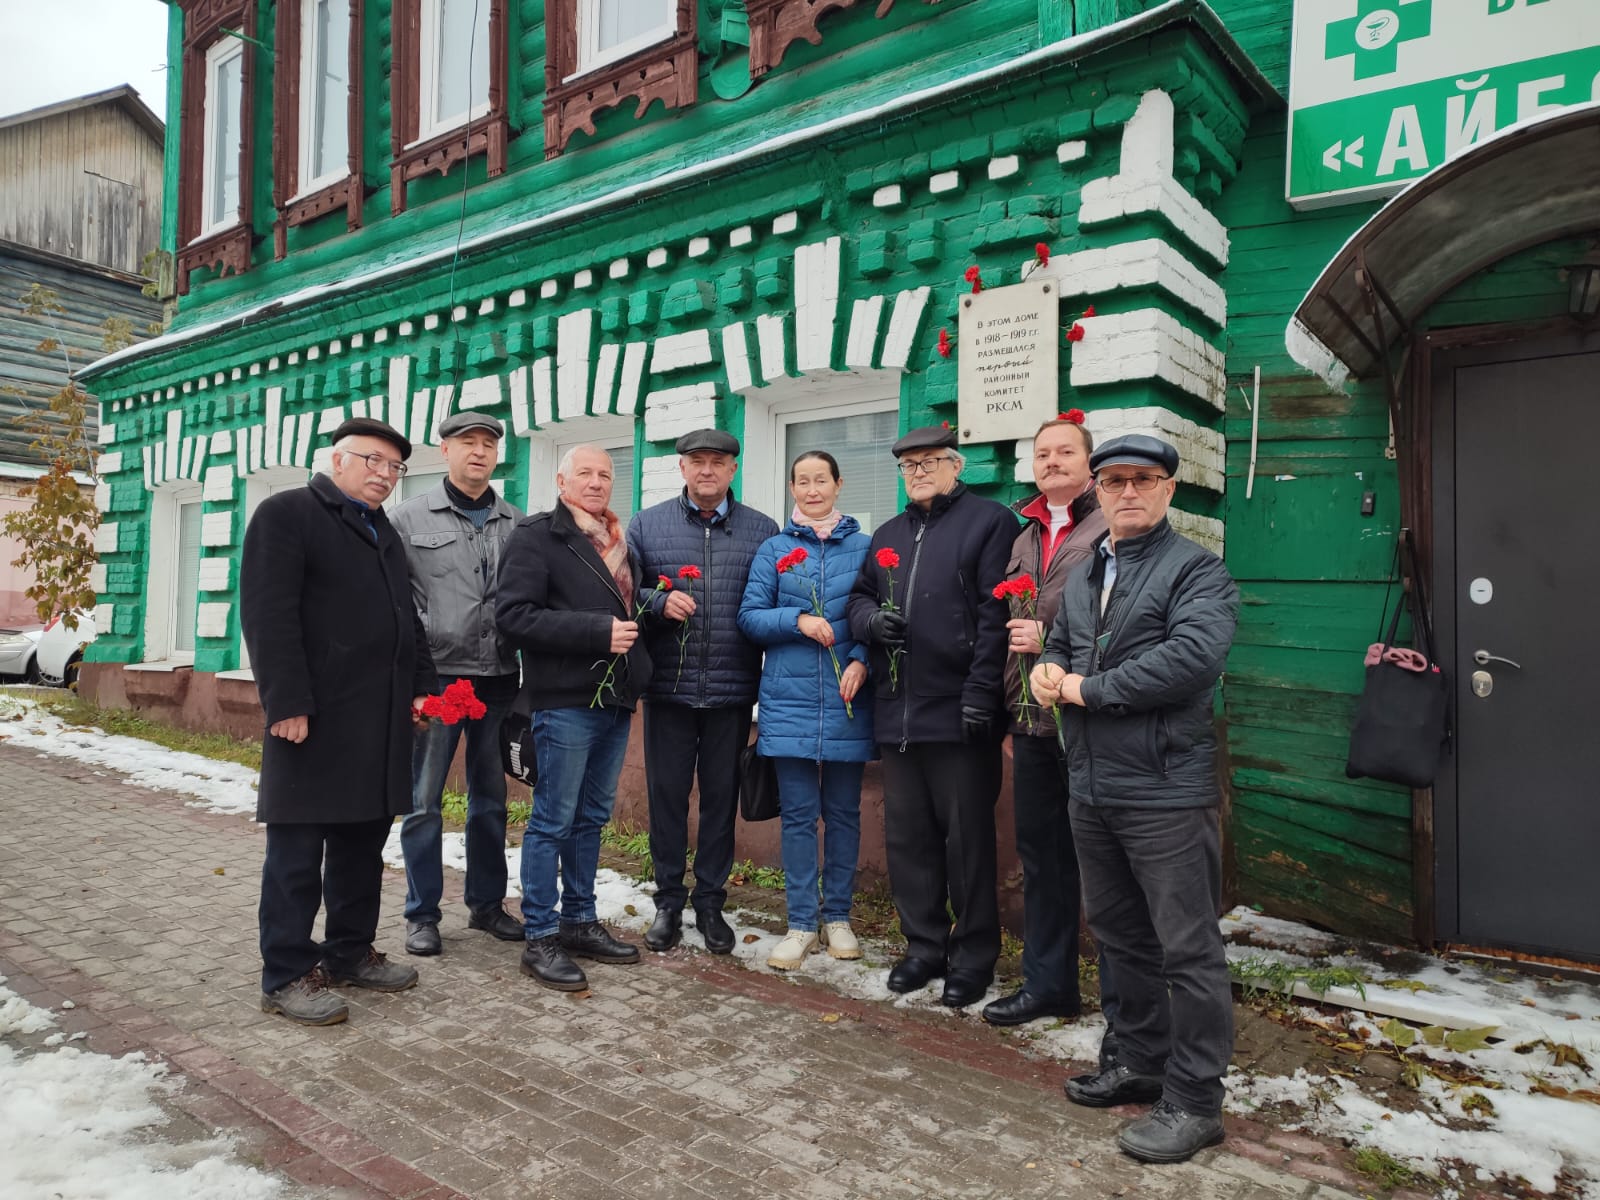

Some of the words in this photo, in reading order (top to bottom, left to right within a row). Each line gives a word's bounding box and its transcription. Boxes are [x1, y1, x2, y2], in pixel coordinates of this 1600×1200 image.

[1322, 70, 1600, 177] «АЙБ
[987, 317, 1011, 327] ЭТОМ
[1014, 312, 1039, 323] ДОМЕ
[977, 343, 1036, 358] РАЗМЕЩАЛСЯ
[976, 355, 1033, 372] первый
[983, 371, 1030, 384] РАЙОННЫЙ
[984, 385, 1025, 398] КОМИТЕТ
[987, 400, 1023, 413] РКСМ
